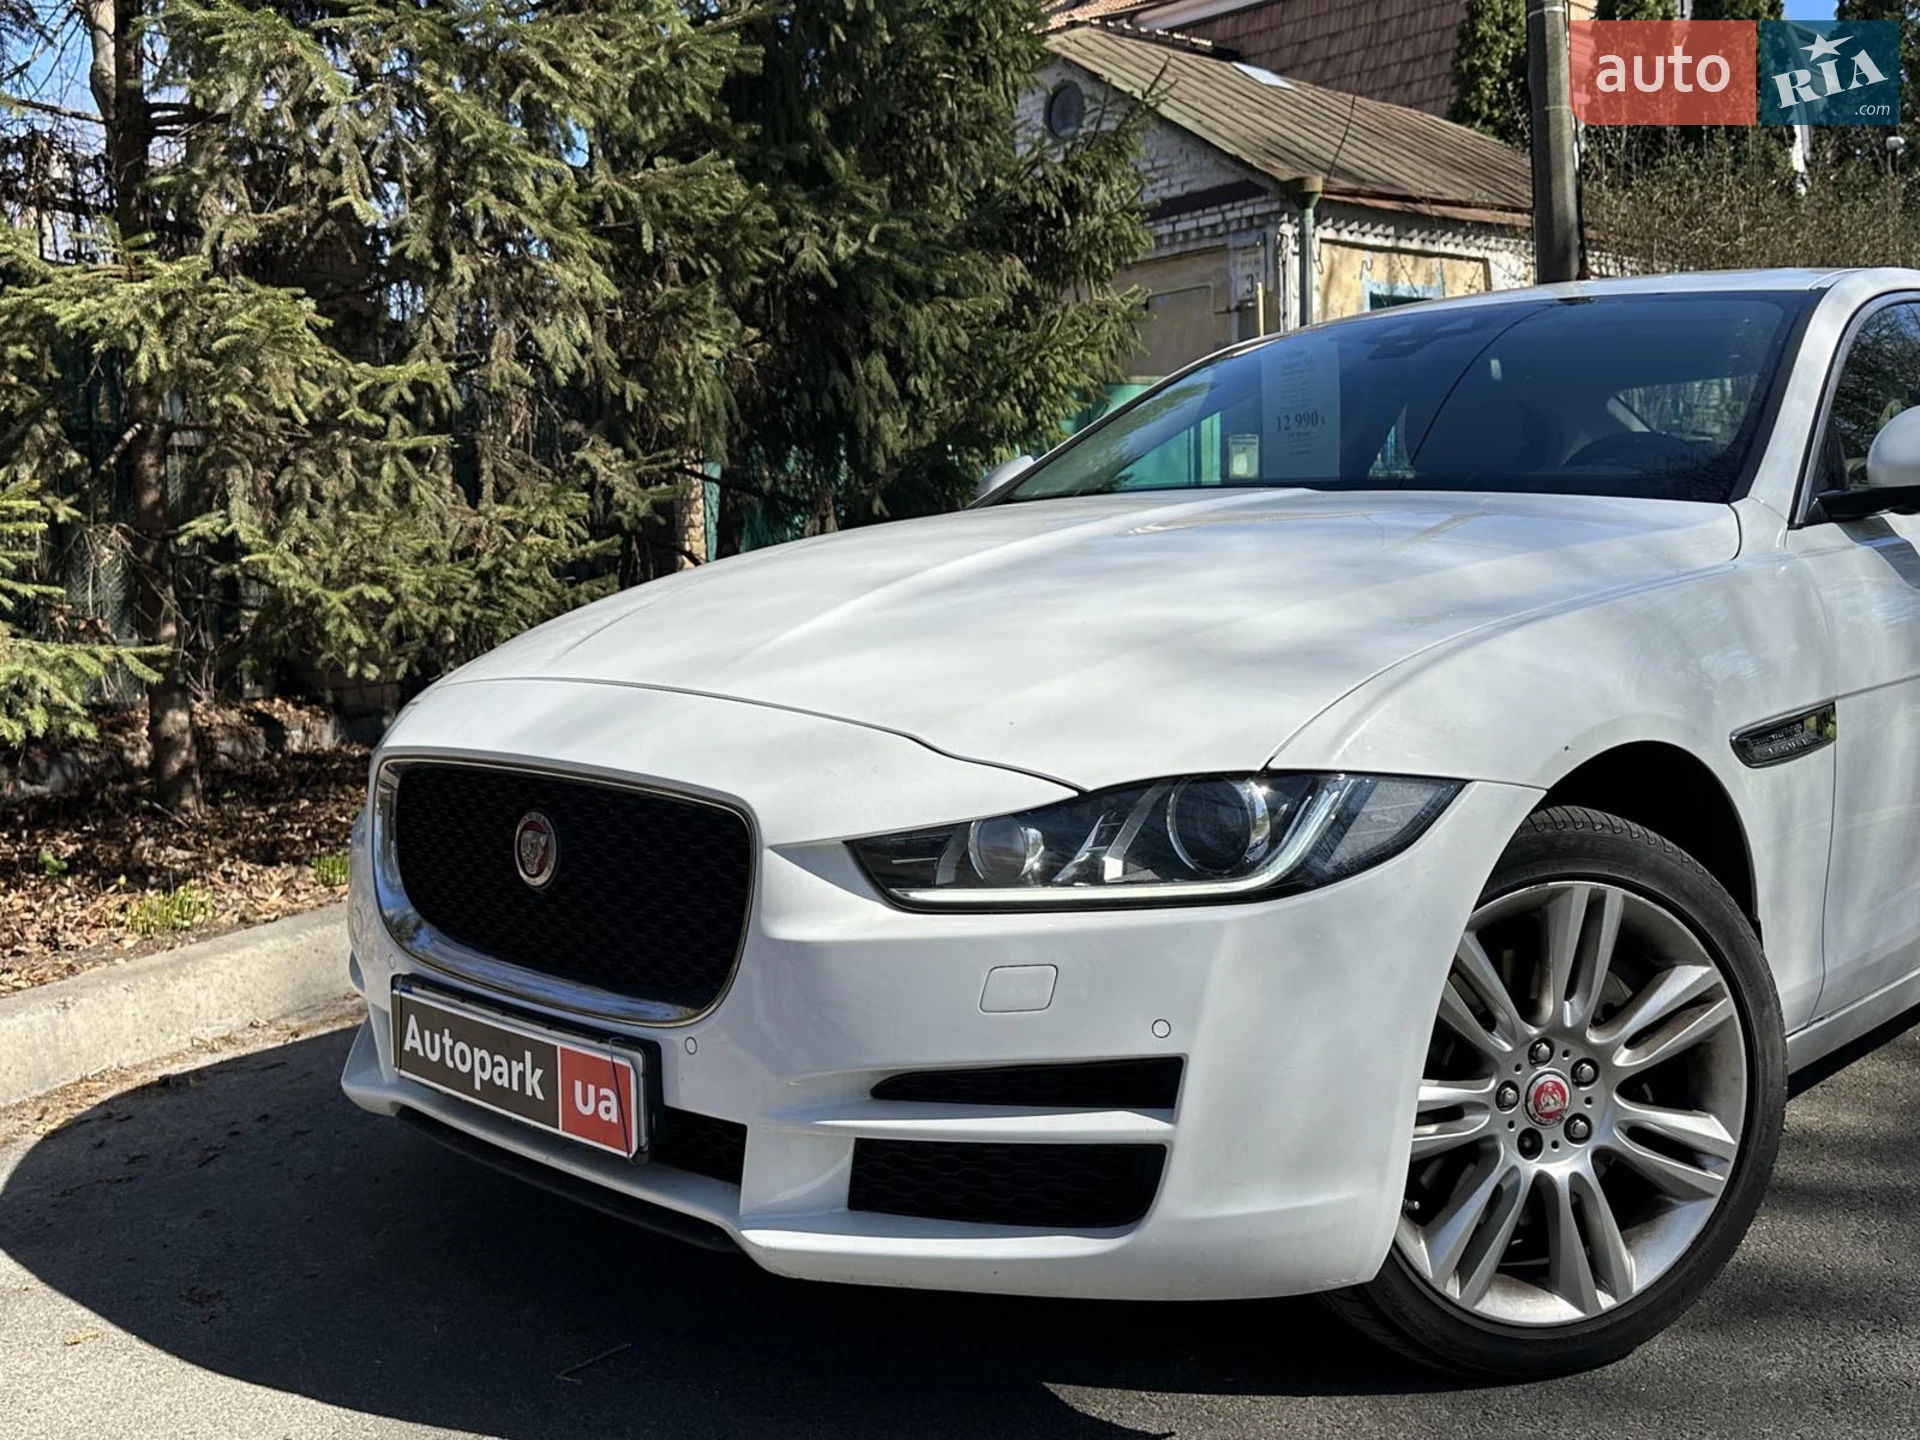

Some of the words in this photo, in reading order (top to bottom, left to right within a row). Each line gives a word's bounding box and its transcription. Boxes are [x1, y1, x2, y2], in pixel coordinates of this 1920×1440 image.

[1276, 413, 1291, 432] 12
[1295, 410, 1318, 431] 990
[403, 1014, 545, 1101] Autopark
[574, 1079, 618, 1124] ua
